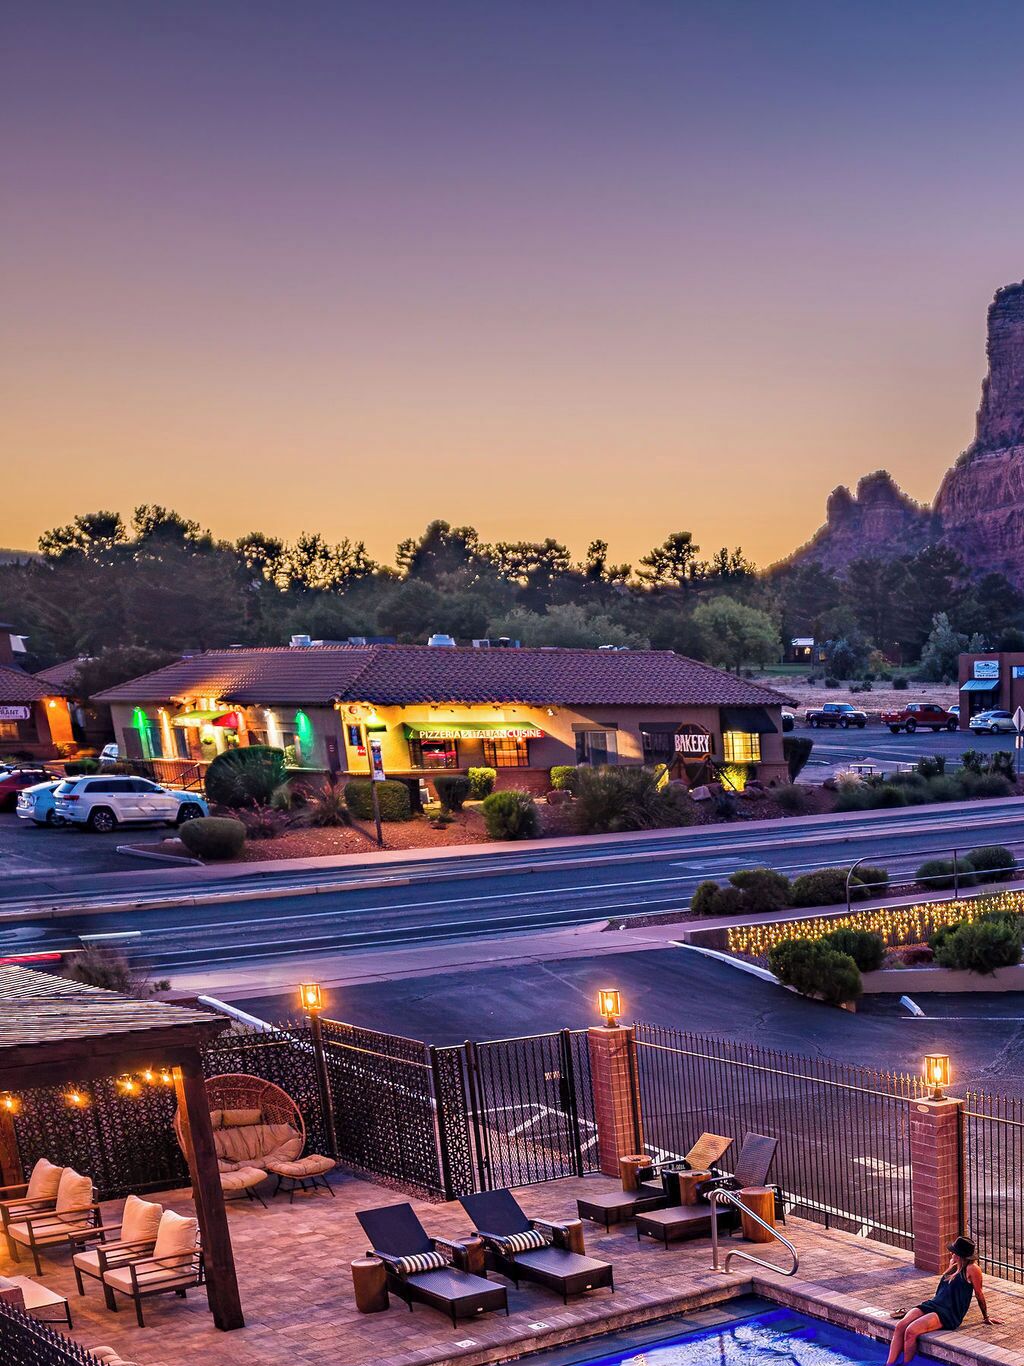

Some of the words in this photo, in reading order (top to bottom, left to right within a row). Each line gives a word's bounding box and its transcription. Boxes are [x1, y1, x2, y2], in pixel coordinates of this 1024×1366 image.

[420, 730, 461, 739] PIZZERIA
[470, 730, 506, 738] ITALIAN
[507, 730, 542, 738] CUISINE
[674, 734, 710, 752] BAKERY
